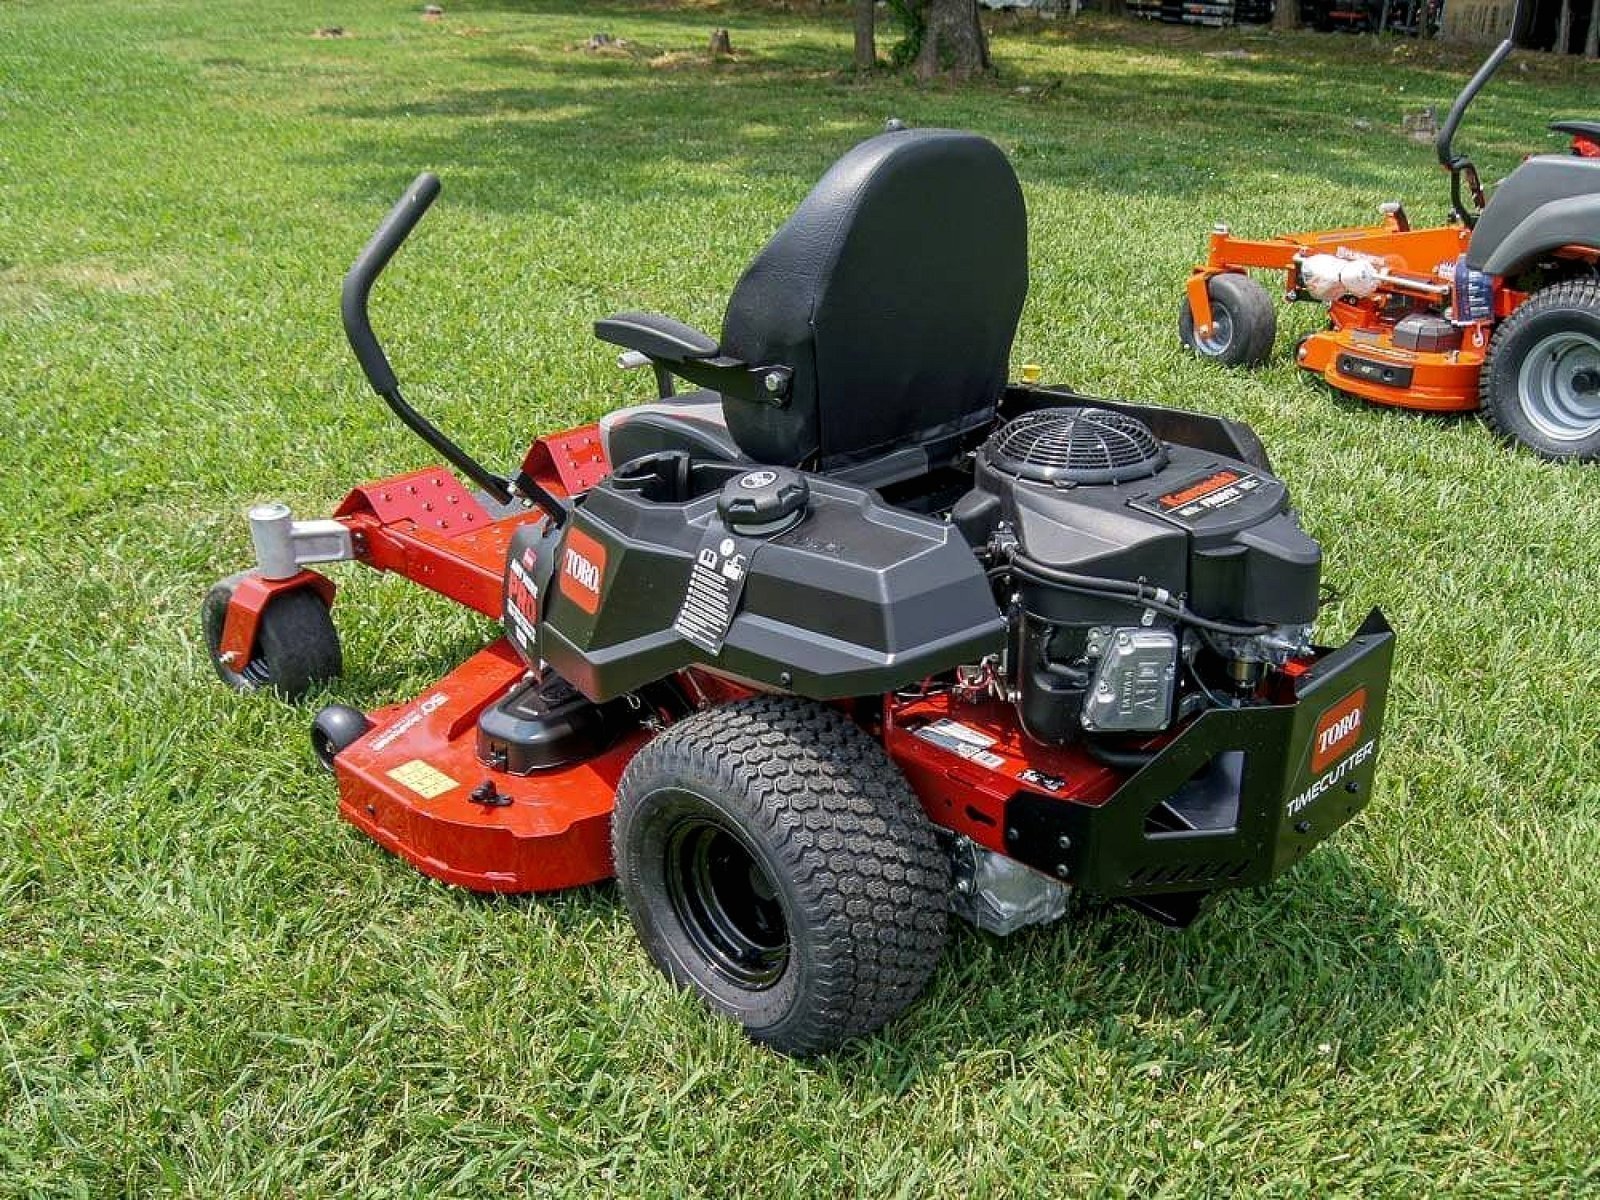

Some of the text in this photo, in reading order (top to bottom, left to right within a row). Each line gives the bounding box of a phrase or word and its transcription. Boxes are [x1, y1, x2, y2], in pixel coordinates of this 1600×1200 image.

[565, 548, 600, 595] TORO
[1319, 708, 1361, 754] TORO
[1286, 738, 1376, 817] TIMECUTTER
